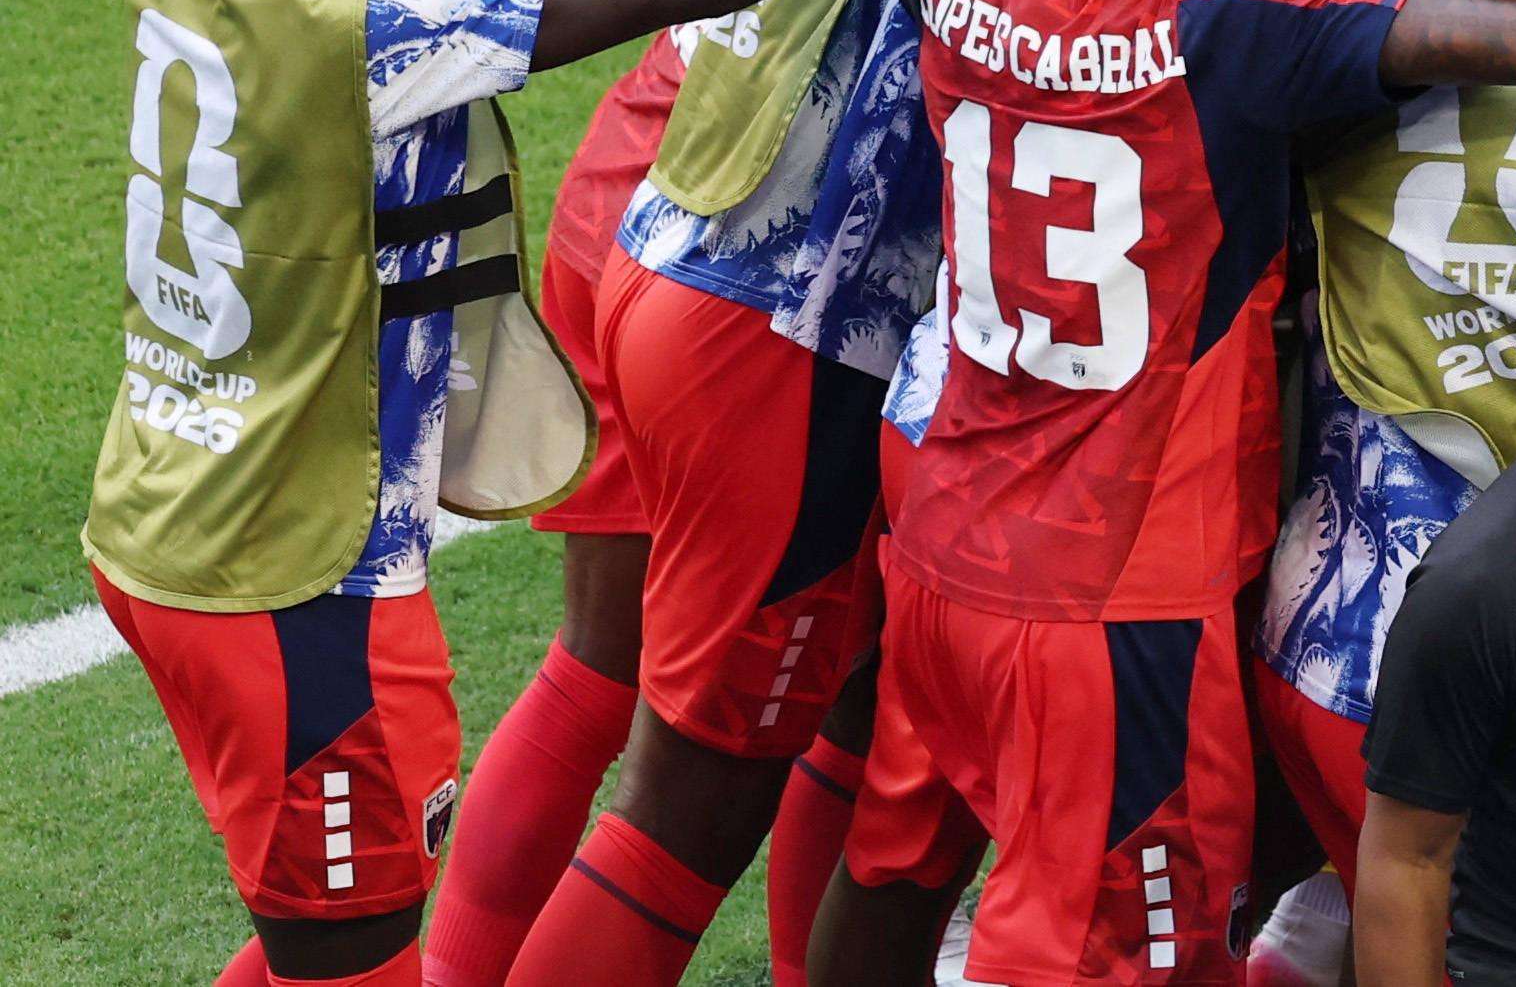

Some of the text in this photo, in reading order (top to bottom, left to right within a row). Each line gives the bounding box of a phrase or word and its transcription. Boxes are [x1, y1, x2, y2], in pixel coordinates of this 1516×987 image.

[942, 98, 1152, 392] 13
[156, 274, 213, 327] FIFA
[1423, 305, 1516, 342] WOR
[125, 331, 257, 404] WORLD CUP
[127, 370, 244, 455] 2026
[426, 783, 454, 813] FCF
